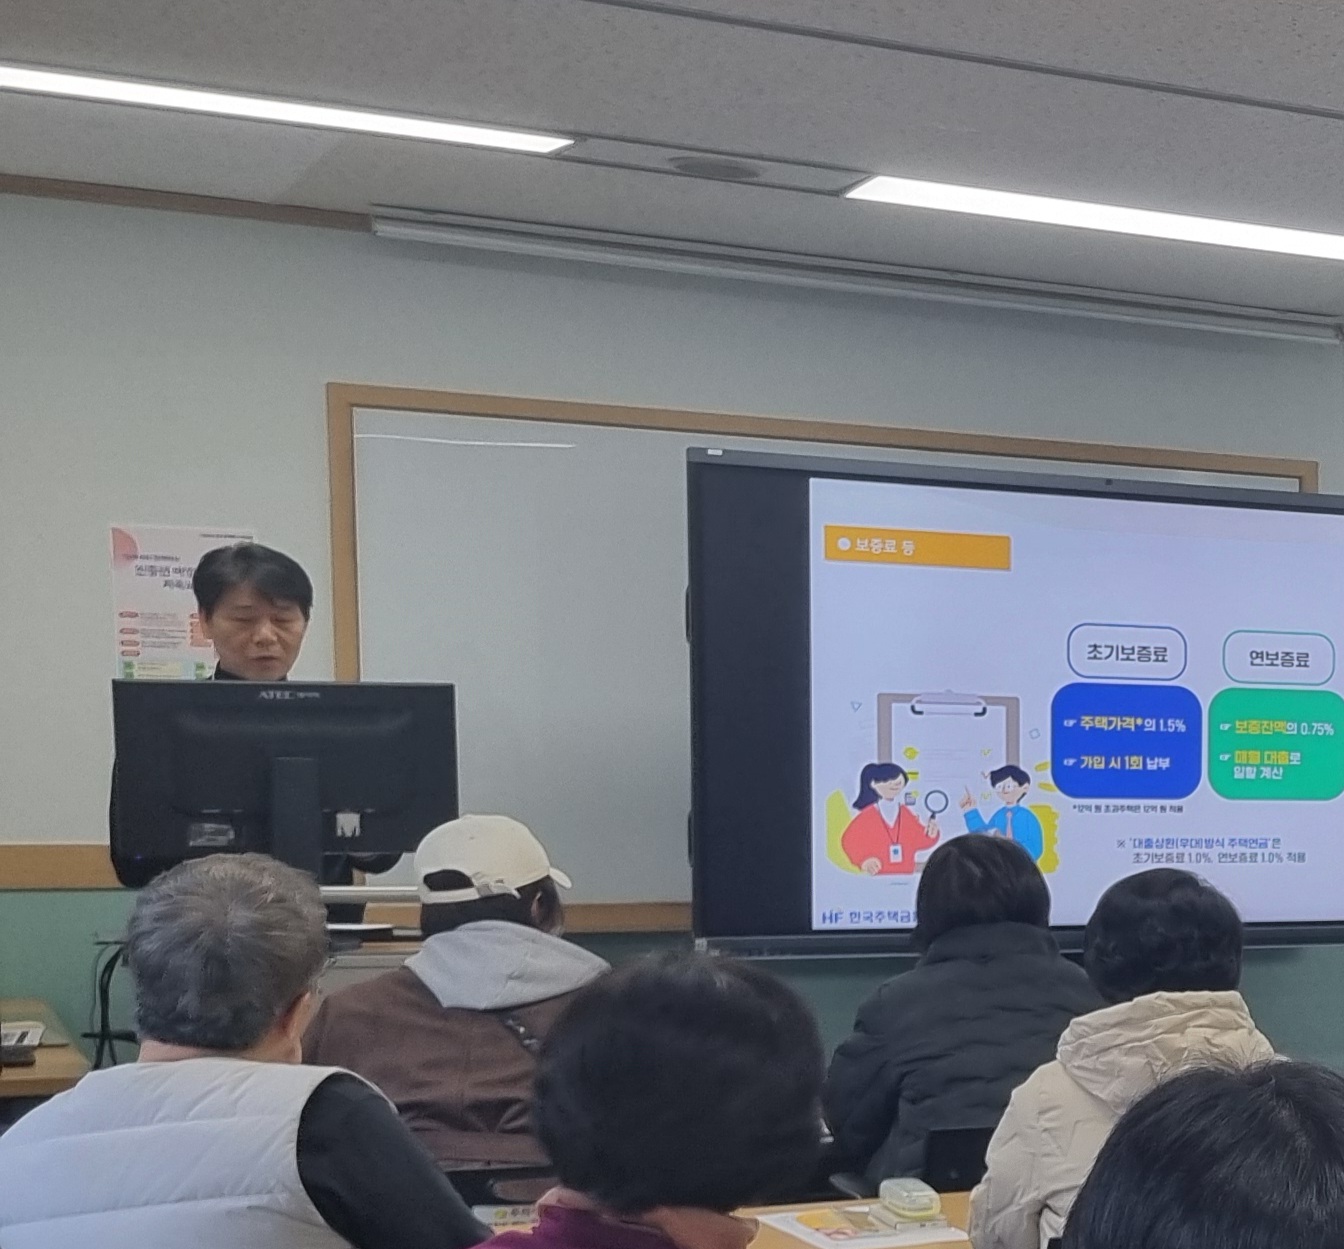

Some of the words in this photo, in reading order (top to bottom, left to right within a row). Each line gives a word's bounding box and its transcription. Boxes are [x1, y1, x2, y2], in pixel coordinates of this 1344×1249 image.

[855, 537, 898, 555] 보증료
[902, 540, 916, 556] 등
[1087, 643, 1168, 663] 초기보증료
[1250, 650, 1310, 668] 연보증료
[1159, 719, 1187, 733] 1.5%
[1235, 720, 1297, 735] 보증잔액의
[1300, 722, 1335, 736] 0.75%
[1080, 755, 1106, 770] 가입
[1108, 756, 1121, 770] 시
[1124, 755, 1143, 770] 1회
[1146, 757, 1170, 771] 납부
[1259, 767, 1284, 780] 계산
[1132, 852, 1185, 864] 초기보증료
[1217, 853, 1258, 865] 연보증료
[1260, 853, 1283, 865] 1.0%
[1286, 852, 1306, 864] 적용
[821, 910, 844, 924] HF
